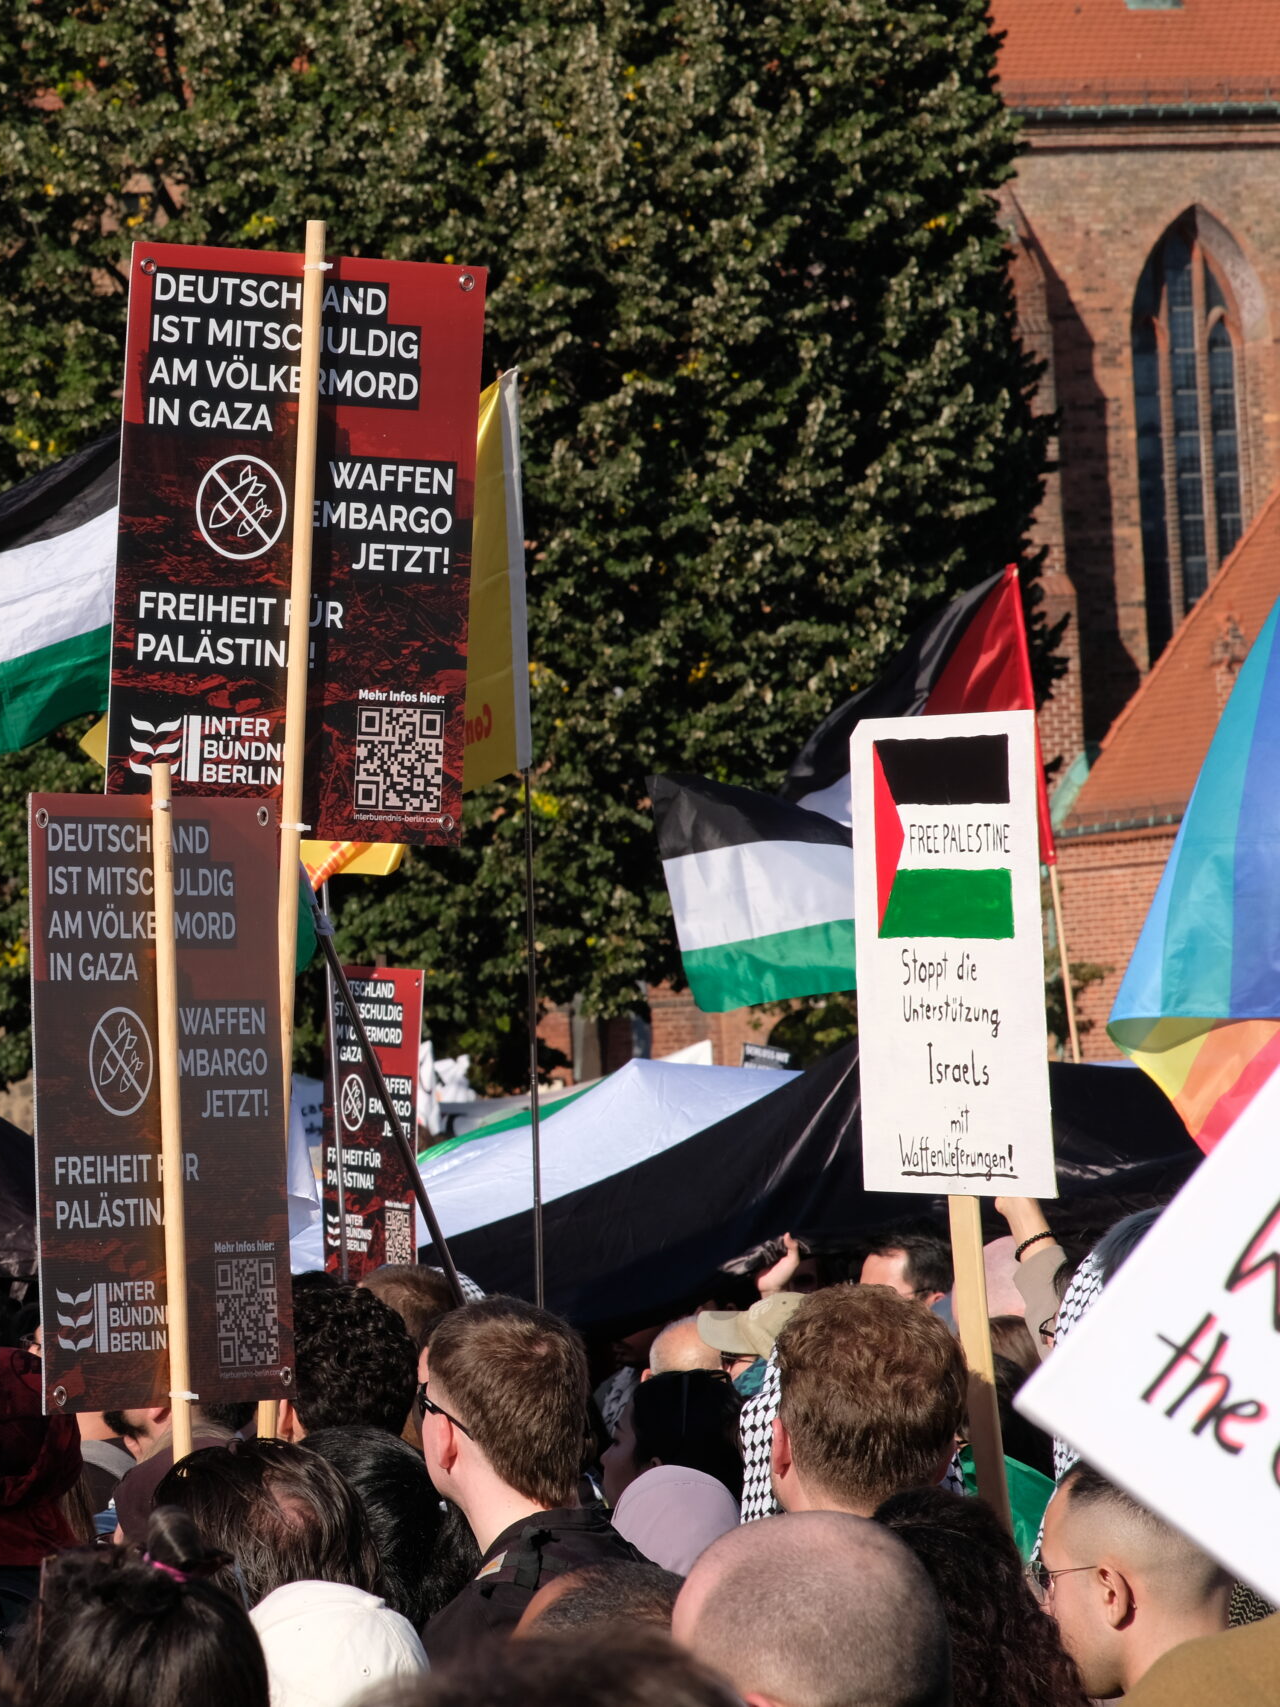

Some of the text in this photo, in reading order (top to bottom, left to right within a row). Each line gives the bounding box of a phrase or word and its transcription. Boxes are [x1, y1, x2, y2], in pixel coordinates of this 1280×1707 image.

[155, 273, 388, 316] DEUTSCHAND
[152, 315, 201, 344] IST
[148, 357, 197, 387] AM
[148, 397, 273, 432] IN GAZA
[329, 461, 454, 496] WAFFEN
[352, 543, 450, 574] JETZT!
[139, 591, 277, 626] FREIHEIT
[136, 628, 316, 668] PALÄSTIN!
[358, 689, 445, 704] Mehr Infos hier:
[204, 715, 270, 737] INTER
[203, 736, 286, 761] BÜNDNI
[202, 764, 282, 785] BERLIN
[47, 866, 234, 897] IST MITSCULDIG
[48, 903, 237, 941] AM VÖLKEMORD
[49, 952, 139, 981] IN GAZA
[901, 948, 978, 992] Stoppt die
[179, 1007, 266, 1035] WAFFEN
[903, 994, 1001, 1038] Unterstützung
[179, 1048, 268, 1077] MBARGO
[340, 1046, 363, 1062] GAZA
[927, 1042, 990, 1086] Israels
[201, 1089, 269, 1118] JETZT!
[950, 1104, 970, 1134] mit
[55, 1154, 152, 1185] FREIHEIT
[364, 1149, 381, 1168] FÜR
[898, 1133, 1014, 1182] Waffenlieferungen!
[214, 1241, 234, 1253] Mehr
[235, 1240, 256, 1252] Infos
[108, 1280, 156, 1302] INTER
[109, 1302, 168, 1328] BÜNDNI
[110, 1330, 167, 1353] BERLIN
[1141, 1313, 1268, 1456] the
